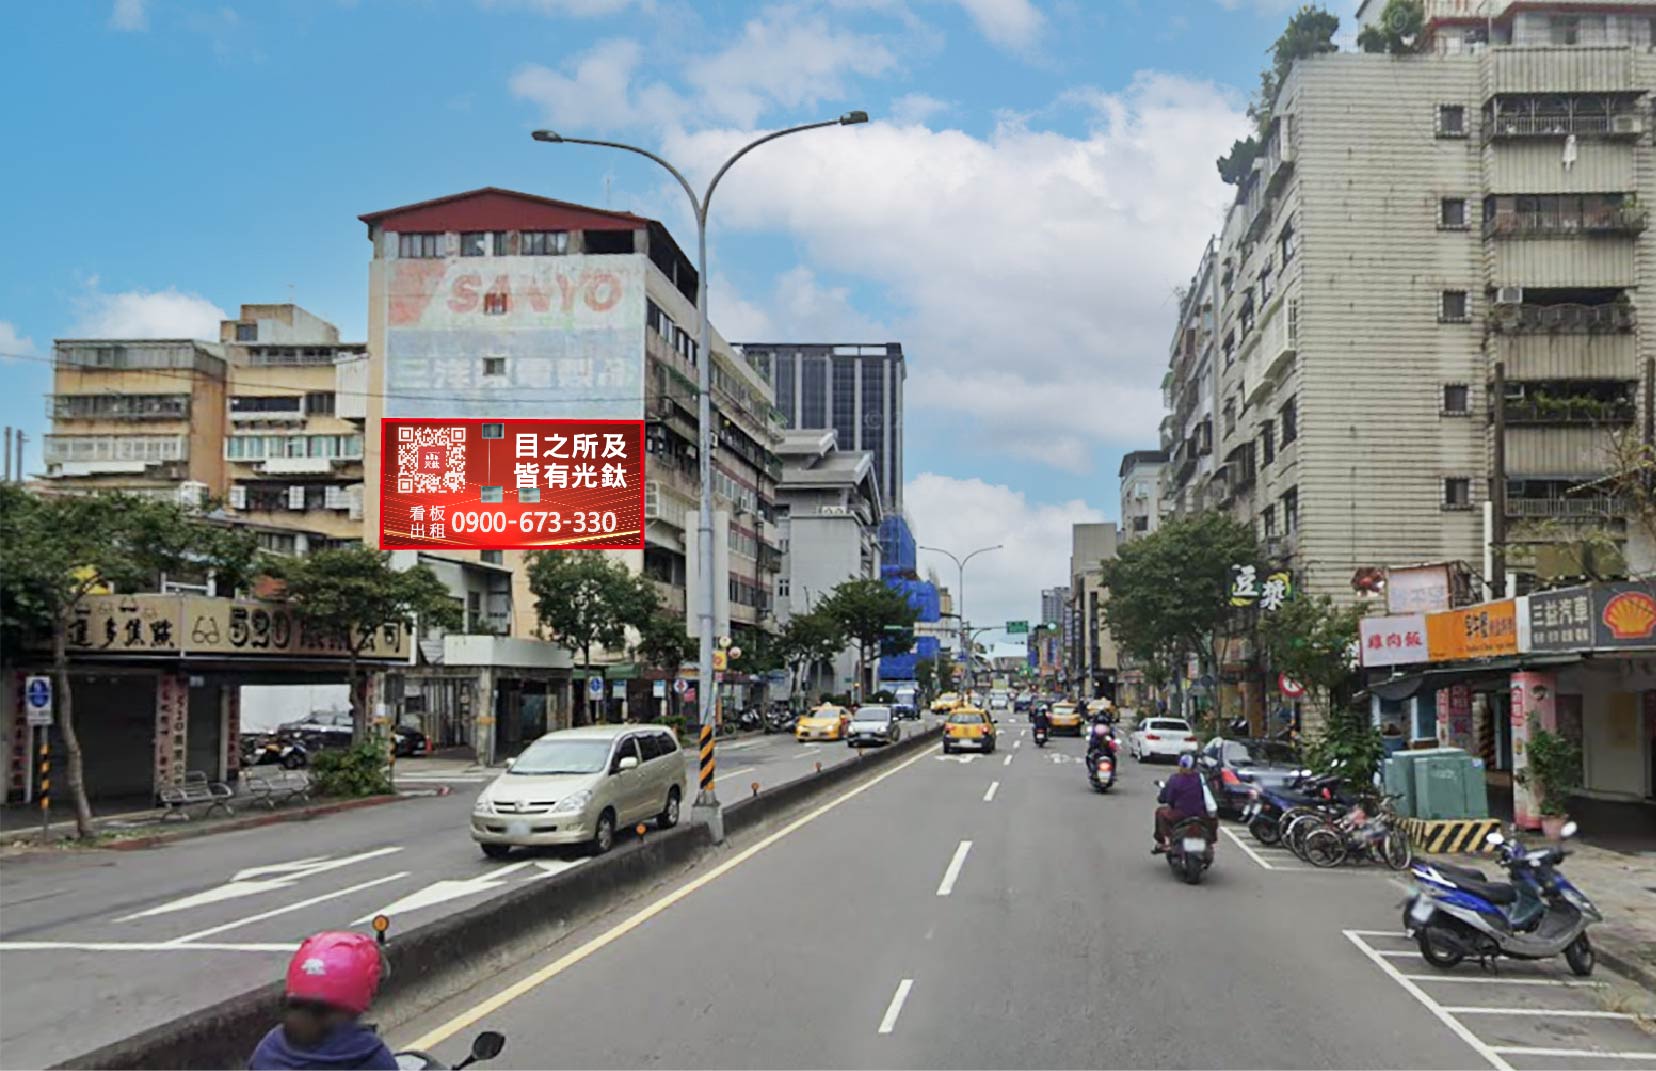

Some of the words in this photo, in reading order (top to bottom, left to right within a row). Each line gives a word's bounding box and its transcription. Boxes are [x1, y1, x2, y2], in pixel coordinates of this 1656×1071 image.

[515, 432, 628, 460] 目之所及
[513, 461, 628, 489] 皆有光鈦
[409, 505, 446, 522] 看板
[451, 511, 617, 534] 0900-673-330
[409, 523, 446, 539] 出租
